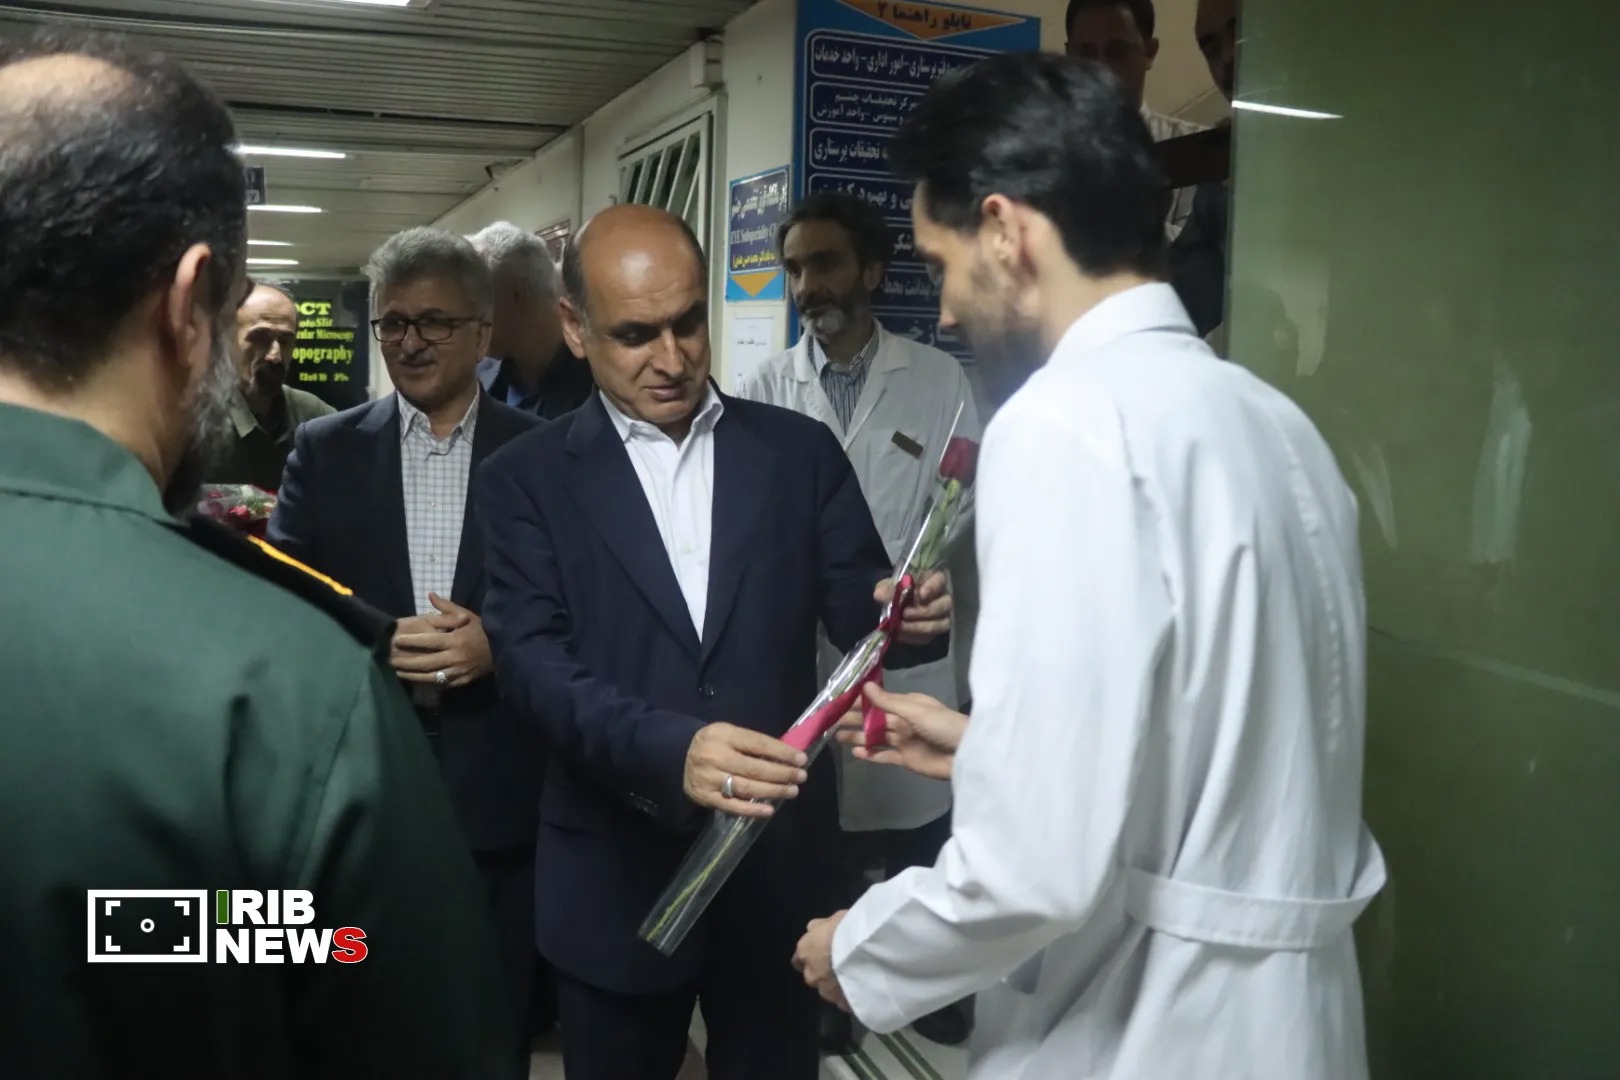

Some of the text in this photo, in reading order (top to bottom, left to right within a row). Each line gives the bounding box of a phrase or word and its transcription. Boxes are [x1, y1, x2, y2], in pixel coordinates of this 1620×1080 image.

[893, 5, 937, 28] راهنما
[814, 136, 848, 162] پرستاری
[849, 140, 880, 162] تحقیقات
[296, 330, 314, 339] cular
[292, 345, 353, 364] opography
